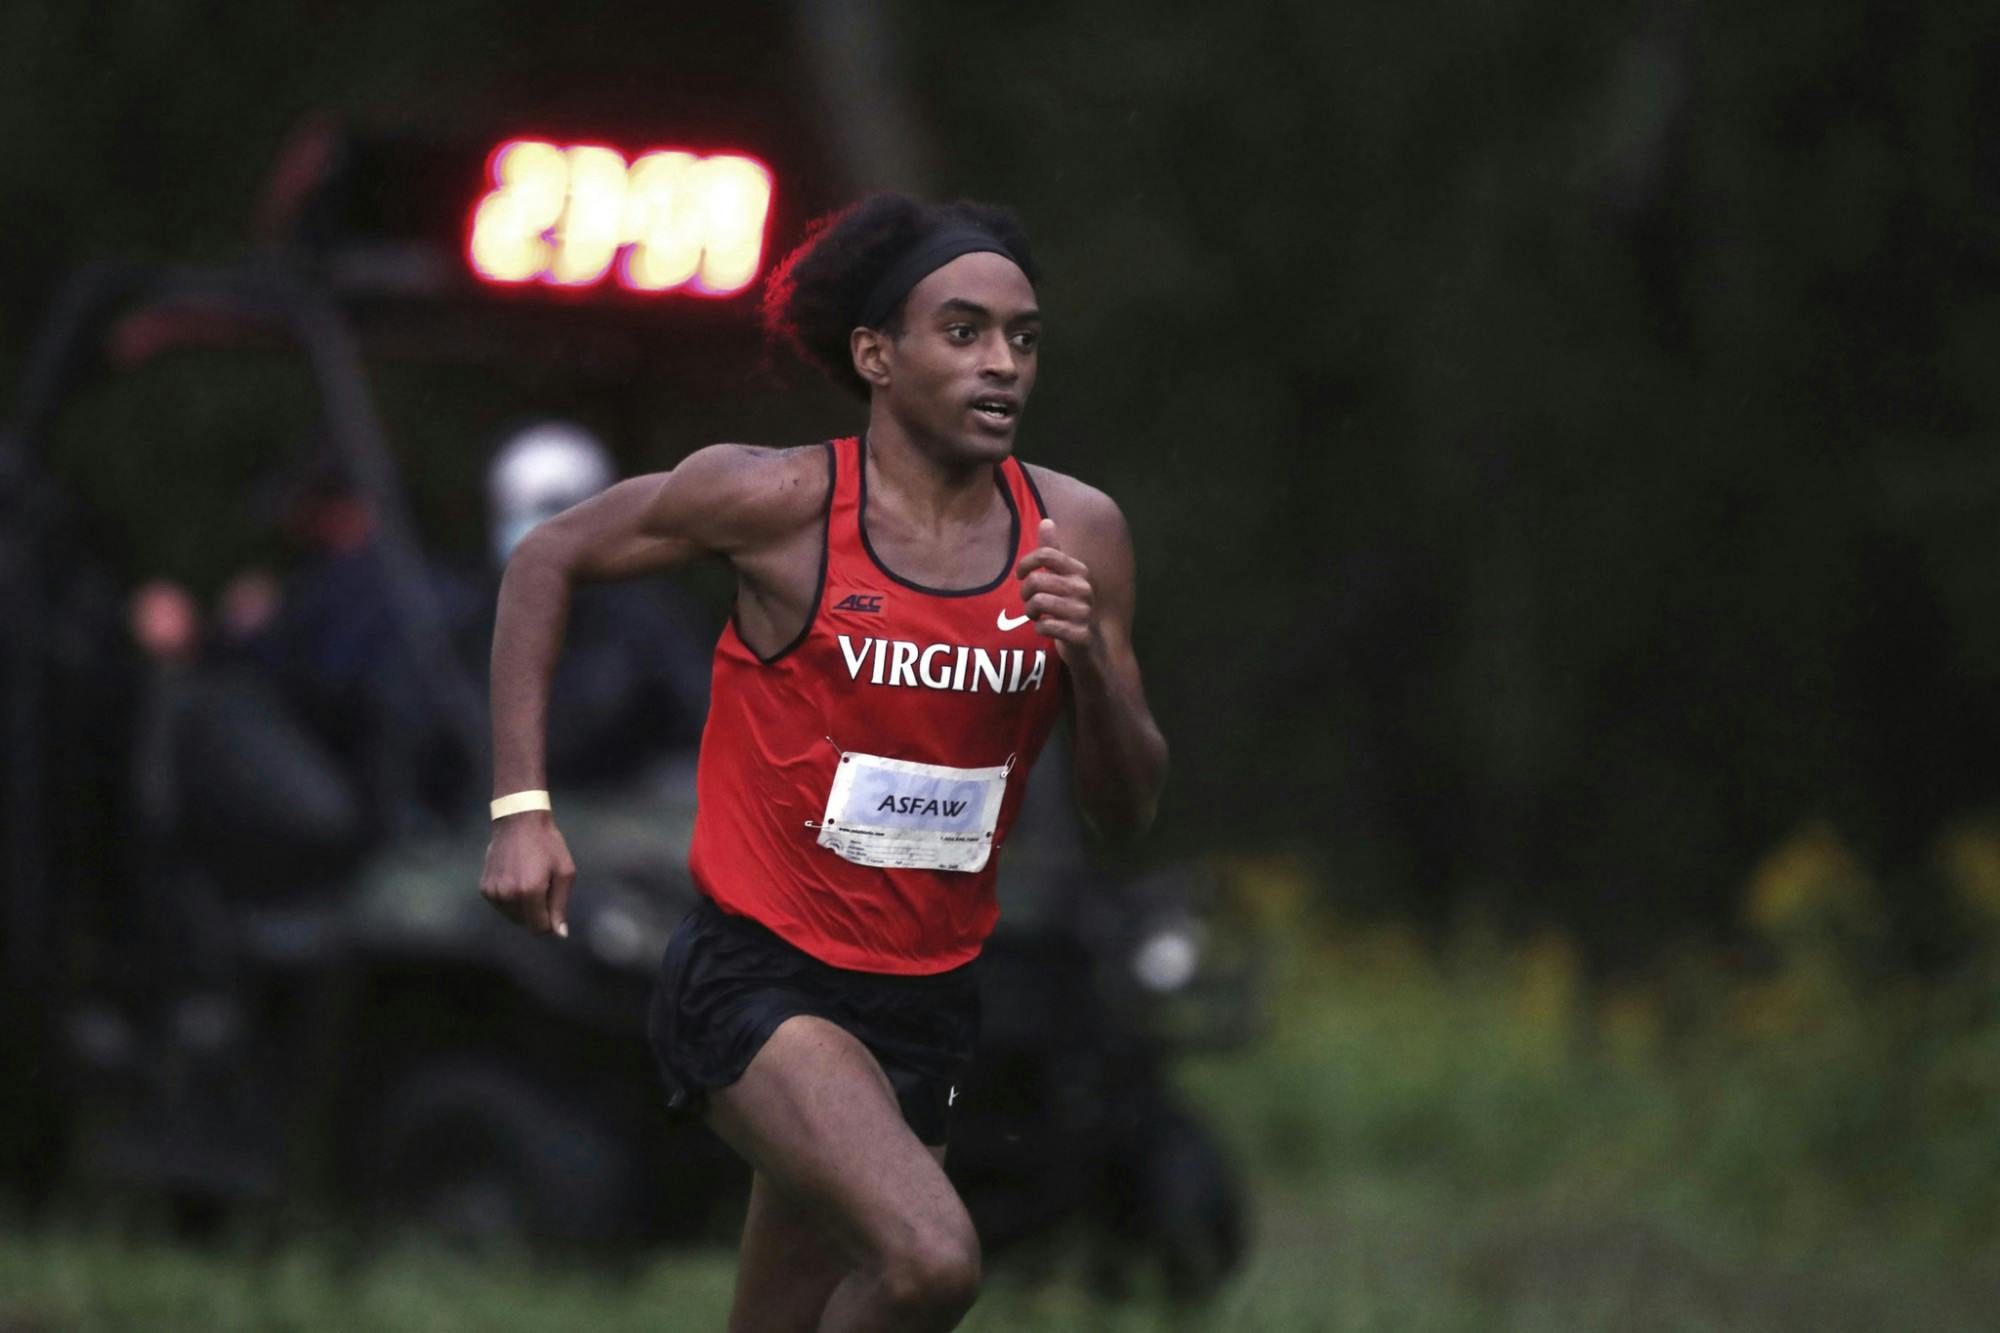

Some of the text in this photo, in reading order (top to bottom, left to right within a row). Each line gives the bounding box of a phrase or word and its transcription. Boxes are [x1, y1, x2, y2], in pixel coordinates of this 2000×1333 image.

[833, 594, 884, 613] ACC
[837, 634, 1047, 694] VIRGINIA
[877, 794, 968, 818] ASFAW
